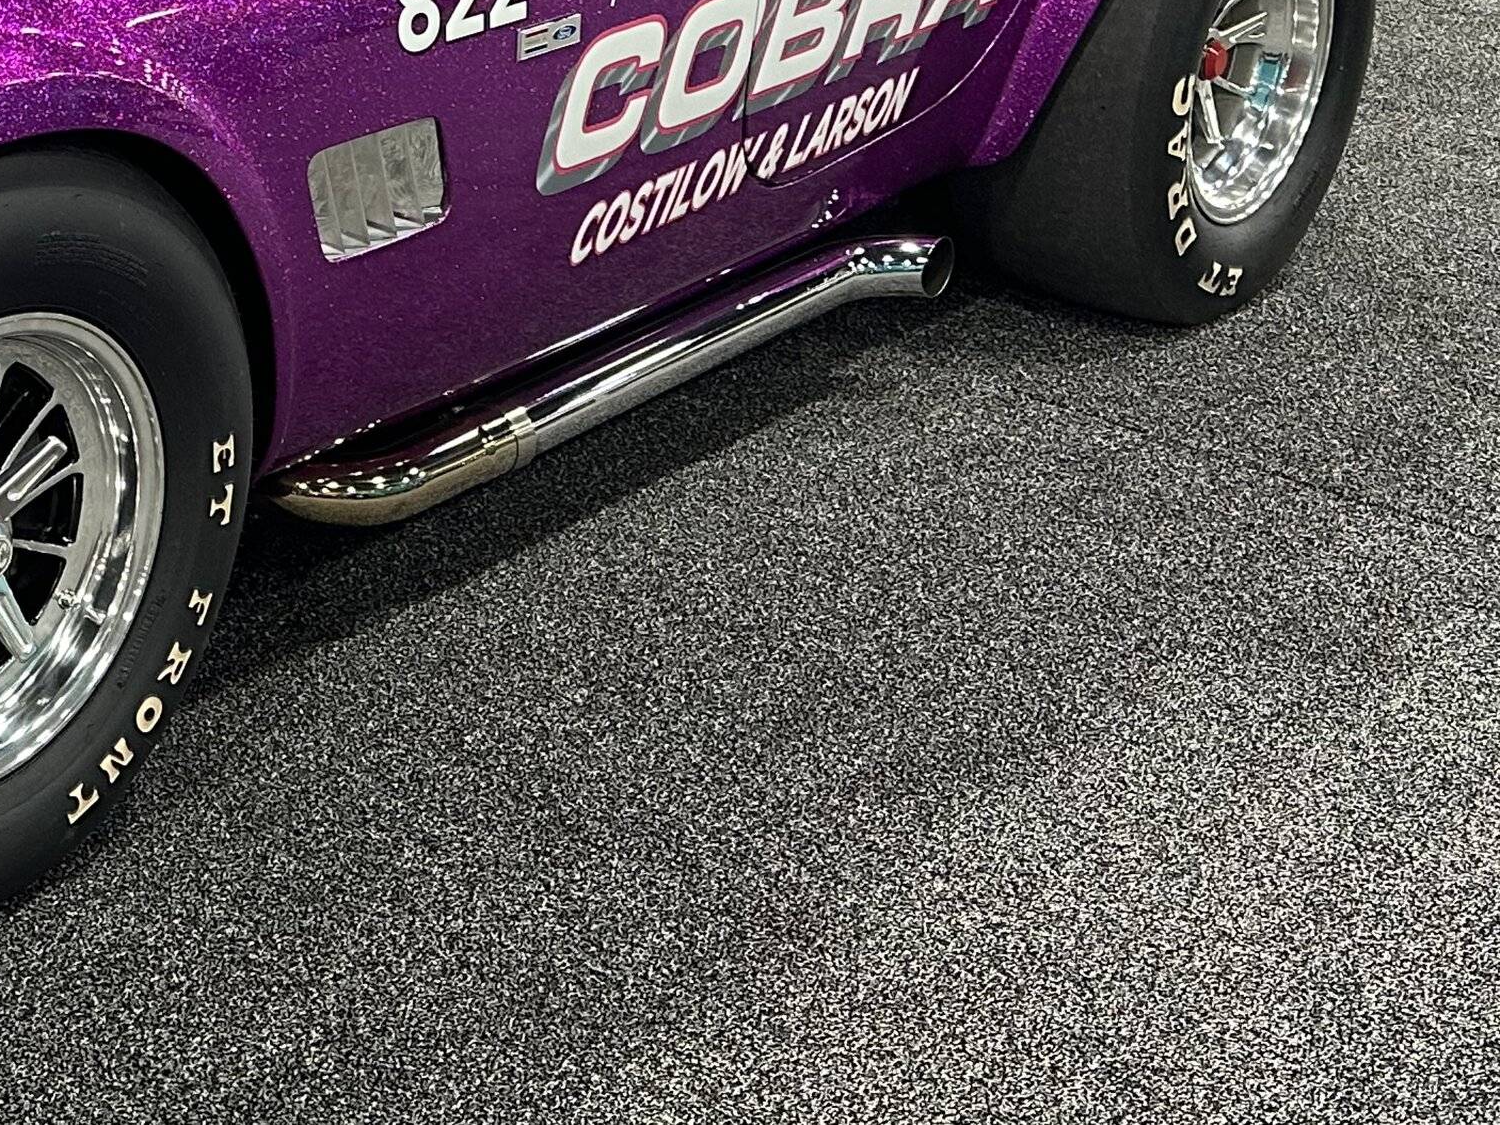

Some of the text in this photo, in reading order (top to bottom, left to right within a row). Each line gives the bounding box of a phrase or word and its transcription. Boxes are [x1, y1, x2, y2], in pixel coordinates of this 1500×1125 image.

[569, 67, 918, 266] COSTILOW & LARSON
[209, 433, 235, 526] ET
[66, 587, 214, 825] FRONT
